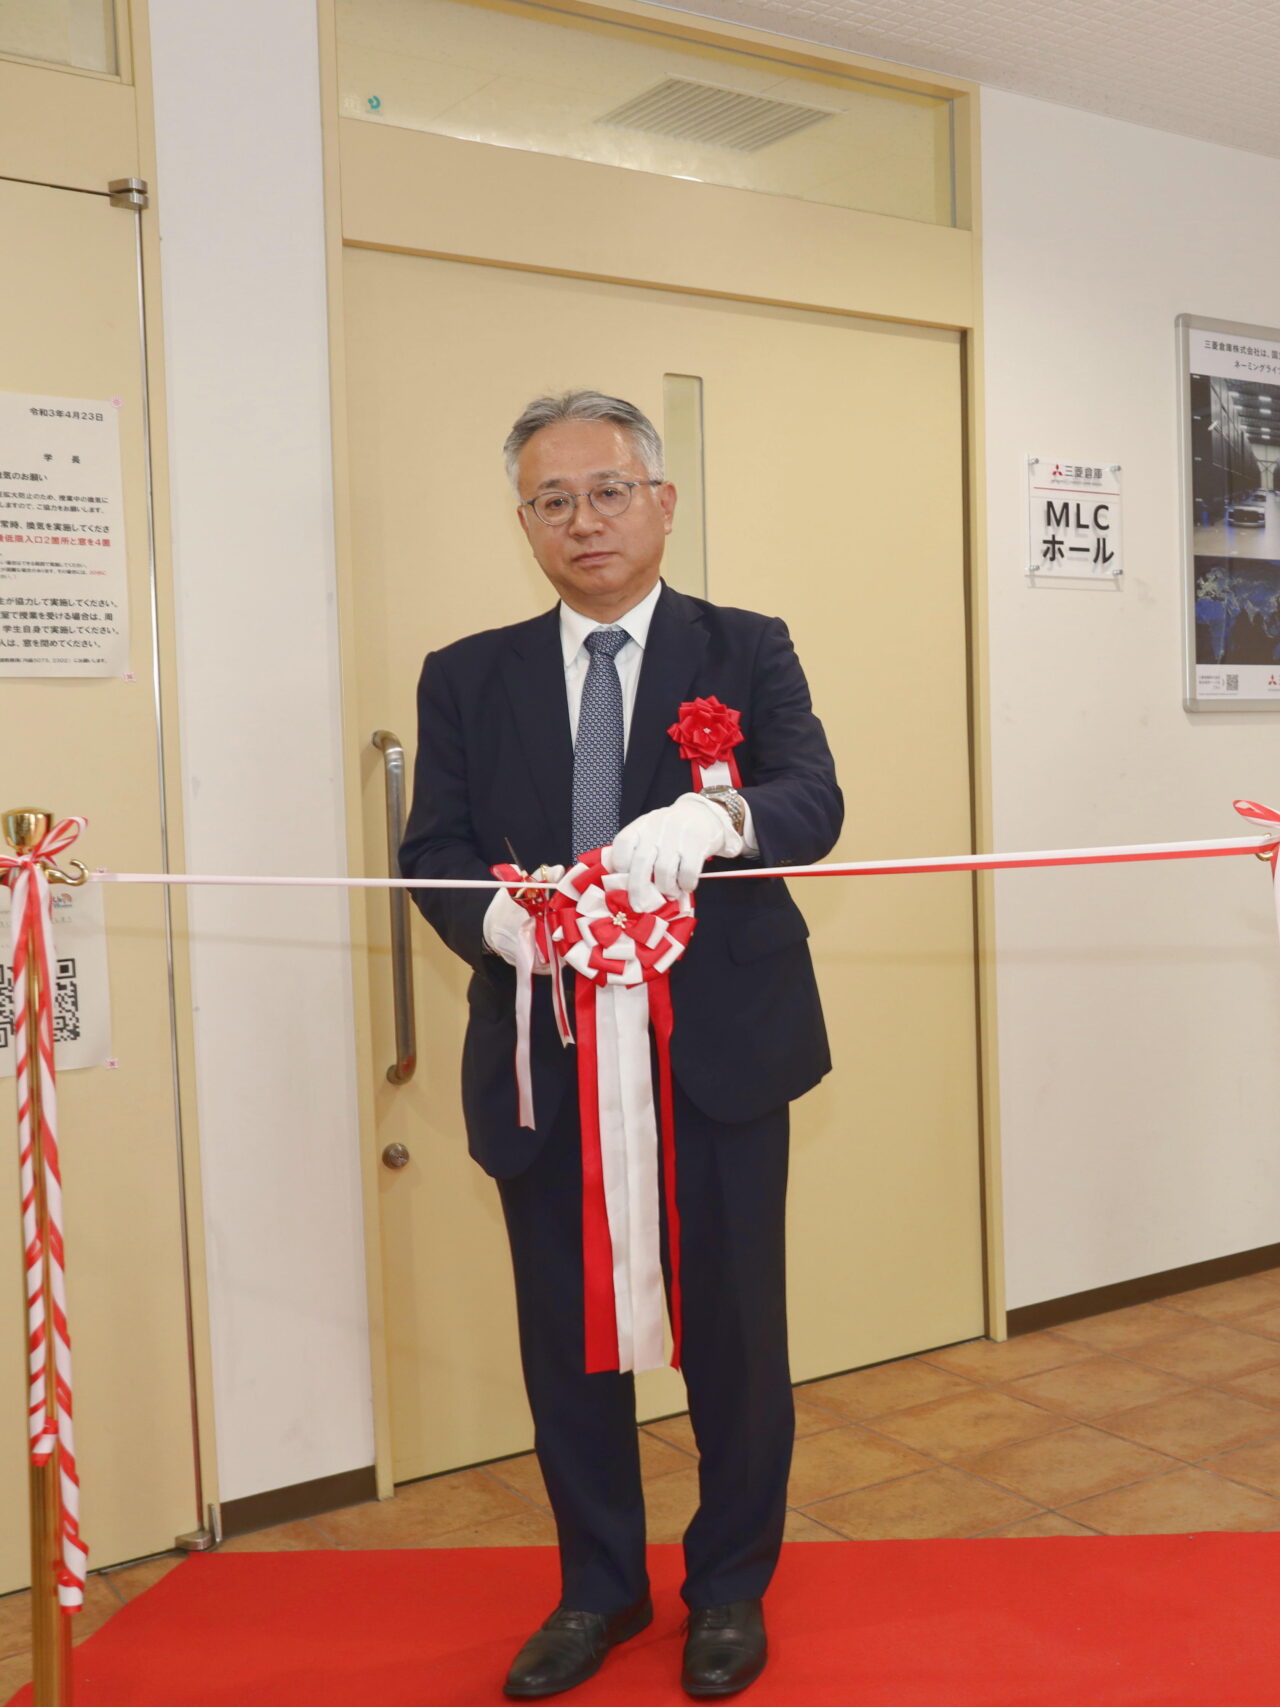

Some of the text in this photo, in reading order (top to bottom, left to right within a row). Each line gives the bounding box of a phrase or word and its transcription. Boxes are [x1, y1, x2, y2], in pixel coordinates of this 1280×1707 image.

[29, 407, 104, 422] 令和3年4月23日
[0, 471, 48, 482] 気のお願い
[1065, 465, 1103, 479] 三菱倉庫
[1046, 500, 1110, 530] MLC
[1042, 534, 1114, 564] ホール
